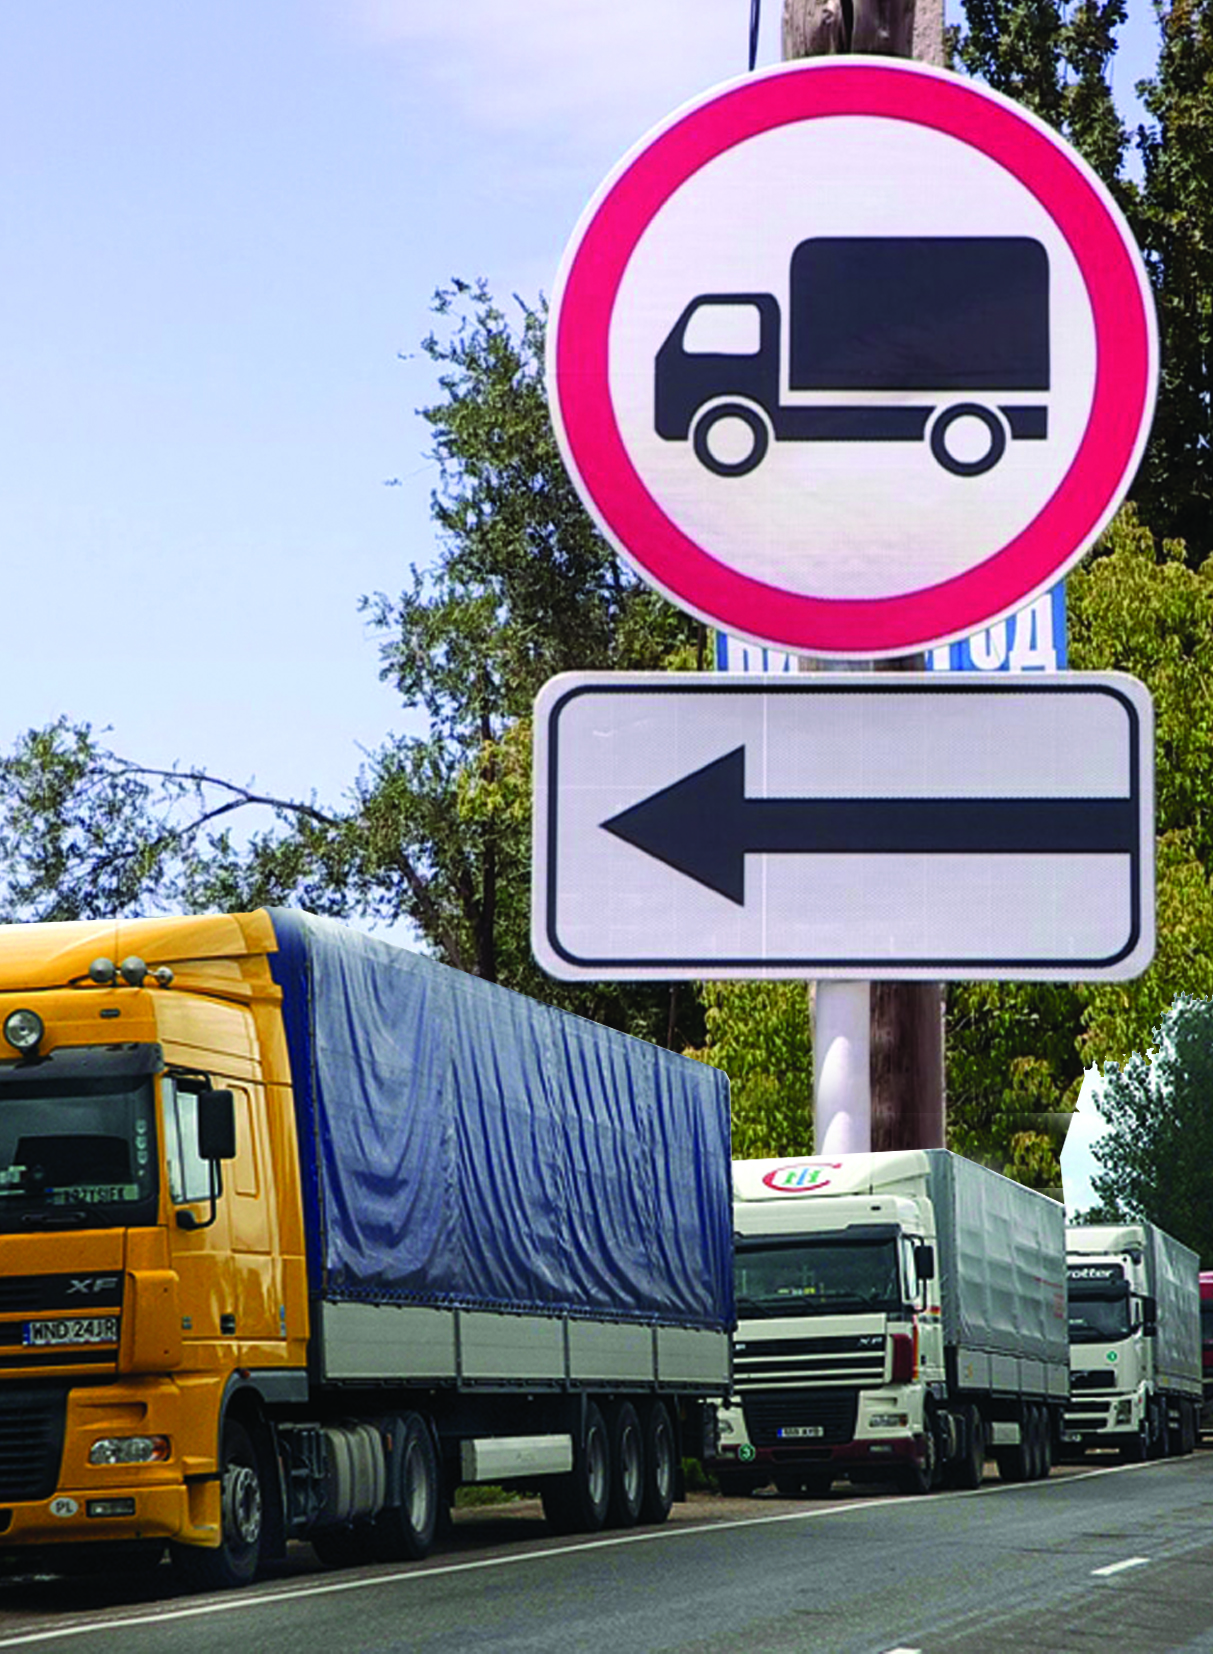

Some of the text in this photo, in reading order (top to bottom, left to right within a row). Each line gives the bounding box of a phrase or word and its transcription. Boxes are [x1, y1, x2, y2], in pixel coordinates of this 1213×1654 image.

[66, 1278, 118, 1294] XF
[31, 1318, 116, 1340] WND 24JR
[55, 1499, 73, 1513] PL
